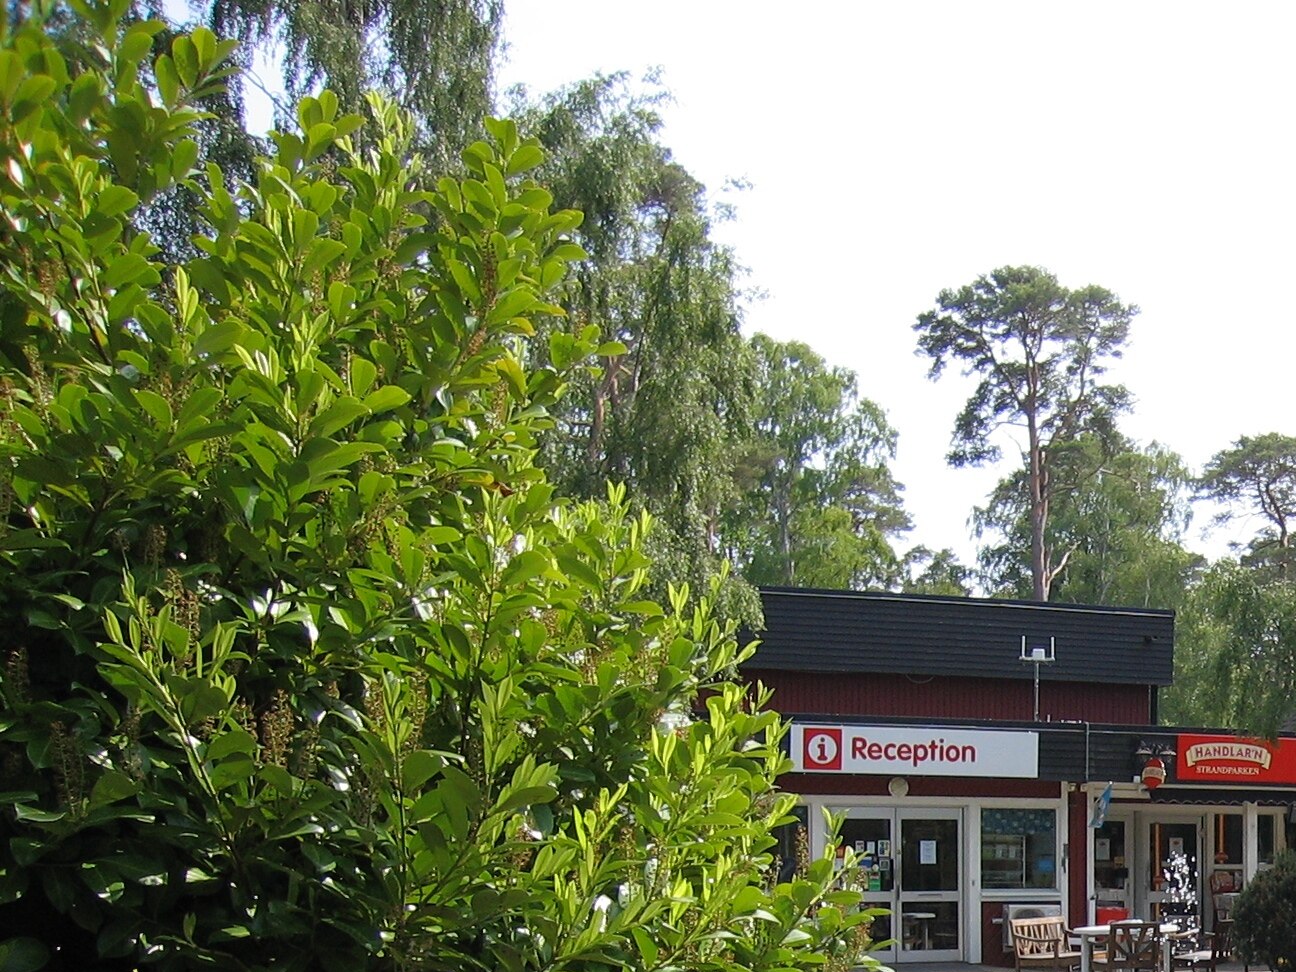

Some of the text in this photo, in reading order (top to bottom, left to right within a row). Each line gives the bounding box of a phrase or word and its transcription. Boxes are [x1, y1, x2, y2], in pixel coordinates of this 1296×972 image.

[851, 736, 976, 767] Reception
[1195, 746, 1263, 759] HANDLAR'N
[1195, 765, 1260, 775] STRANDPARKEN
